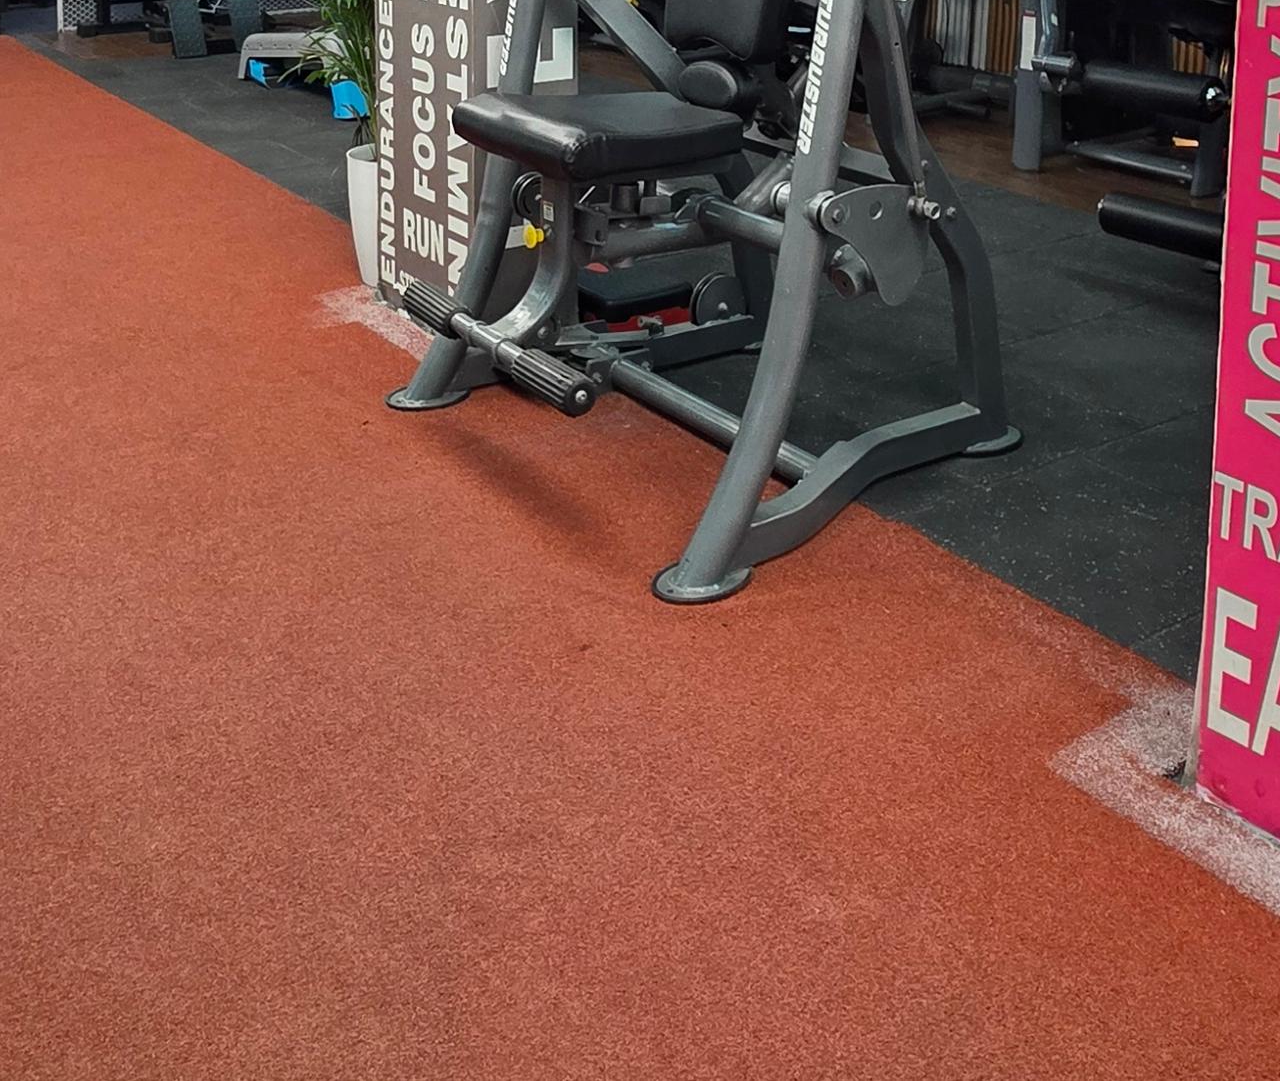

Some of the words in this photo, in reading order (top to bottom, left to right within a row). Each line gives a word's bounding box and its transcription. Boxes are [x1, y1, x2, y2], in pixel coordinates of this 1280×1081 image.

[411, 22, 436, 204] FOCUS
[446, 15, 469, 298] STAMIN
[403, 207, 445, 267] RUN
